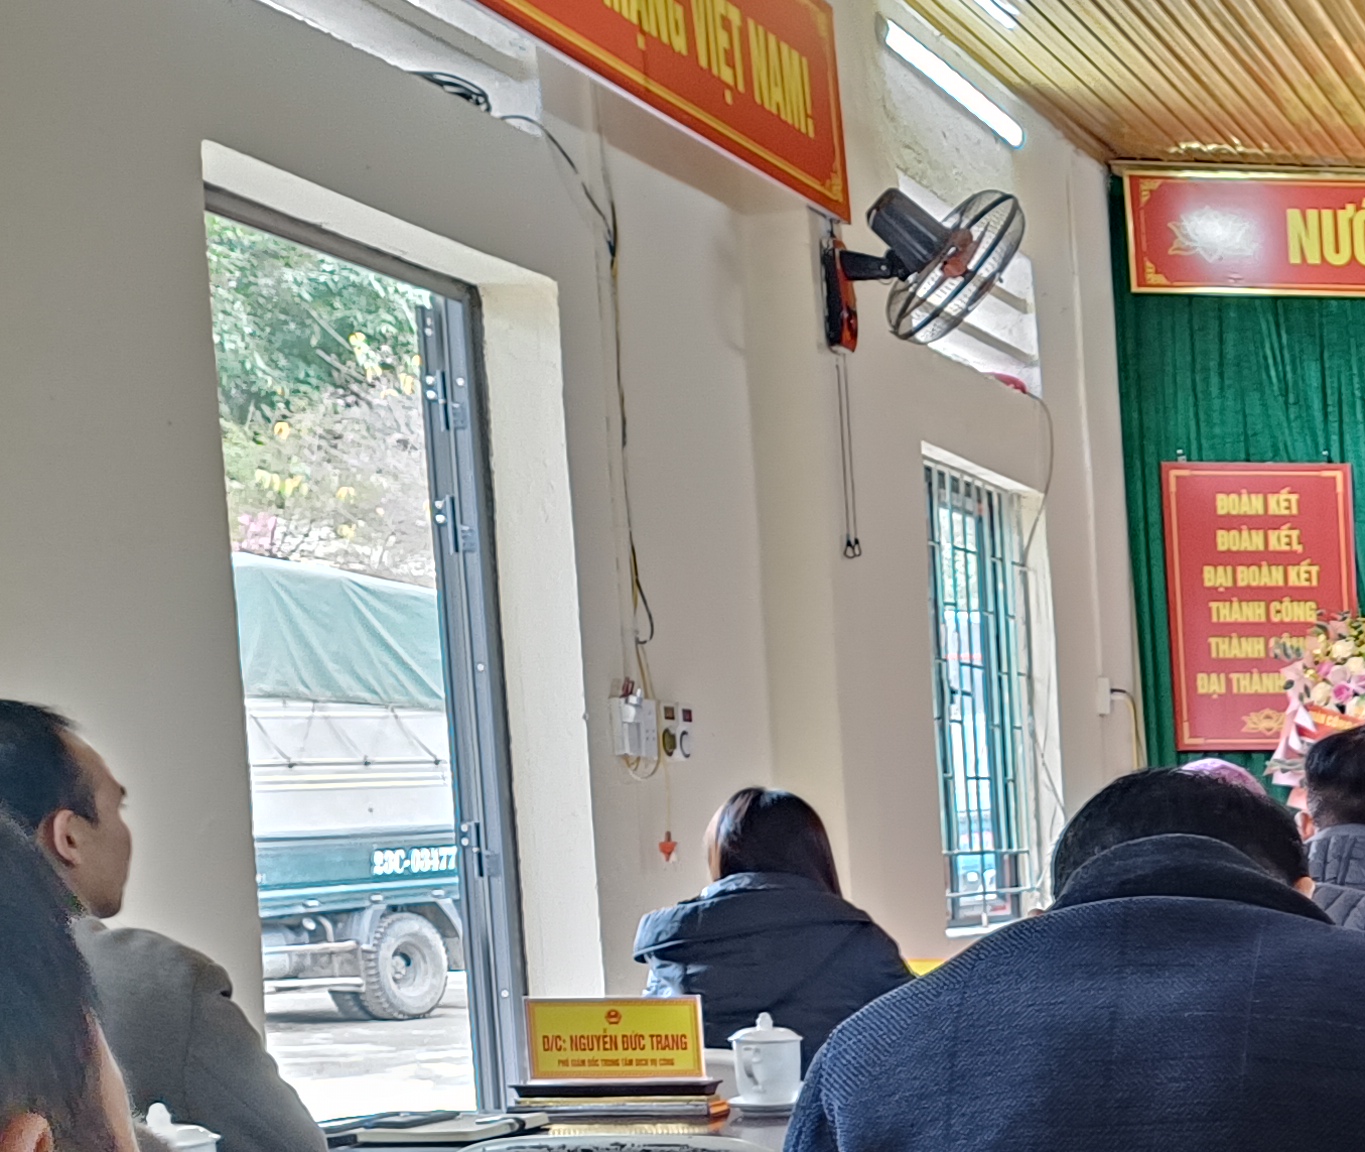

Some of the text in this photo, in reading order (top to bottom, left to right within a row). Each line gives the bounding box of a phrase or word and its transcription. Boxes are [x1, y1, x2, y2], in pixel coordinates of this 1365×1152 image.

[747, 17, 815, 139] NAM!
[1216, 487, 1299, 515] ĐOÀN KẾT
[1216, 523, 1303, 553] ĐOÀN KẾT,
[1203, 559, 1319, 591] ĐẠI ĐOÀN KẾT
[1209, 598, 1317, 622] THÀNH CÔNG
[1208, 633, 1265, 658] THÀNH
[1197, 672, 1225, 698] ĐẠI
[649, 1034, 688, 1050] TRANG
